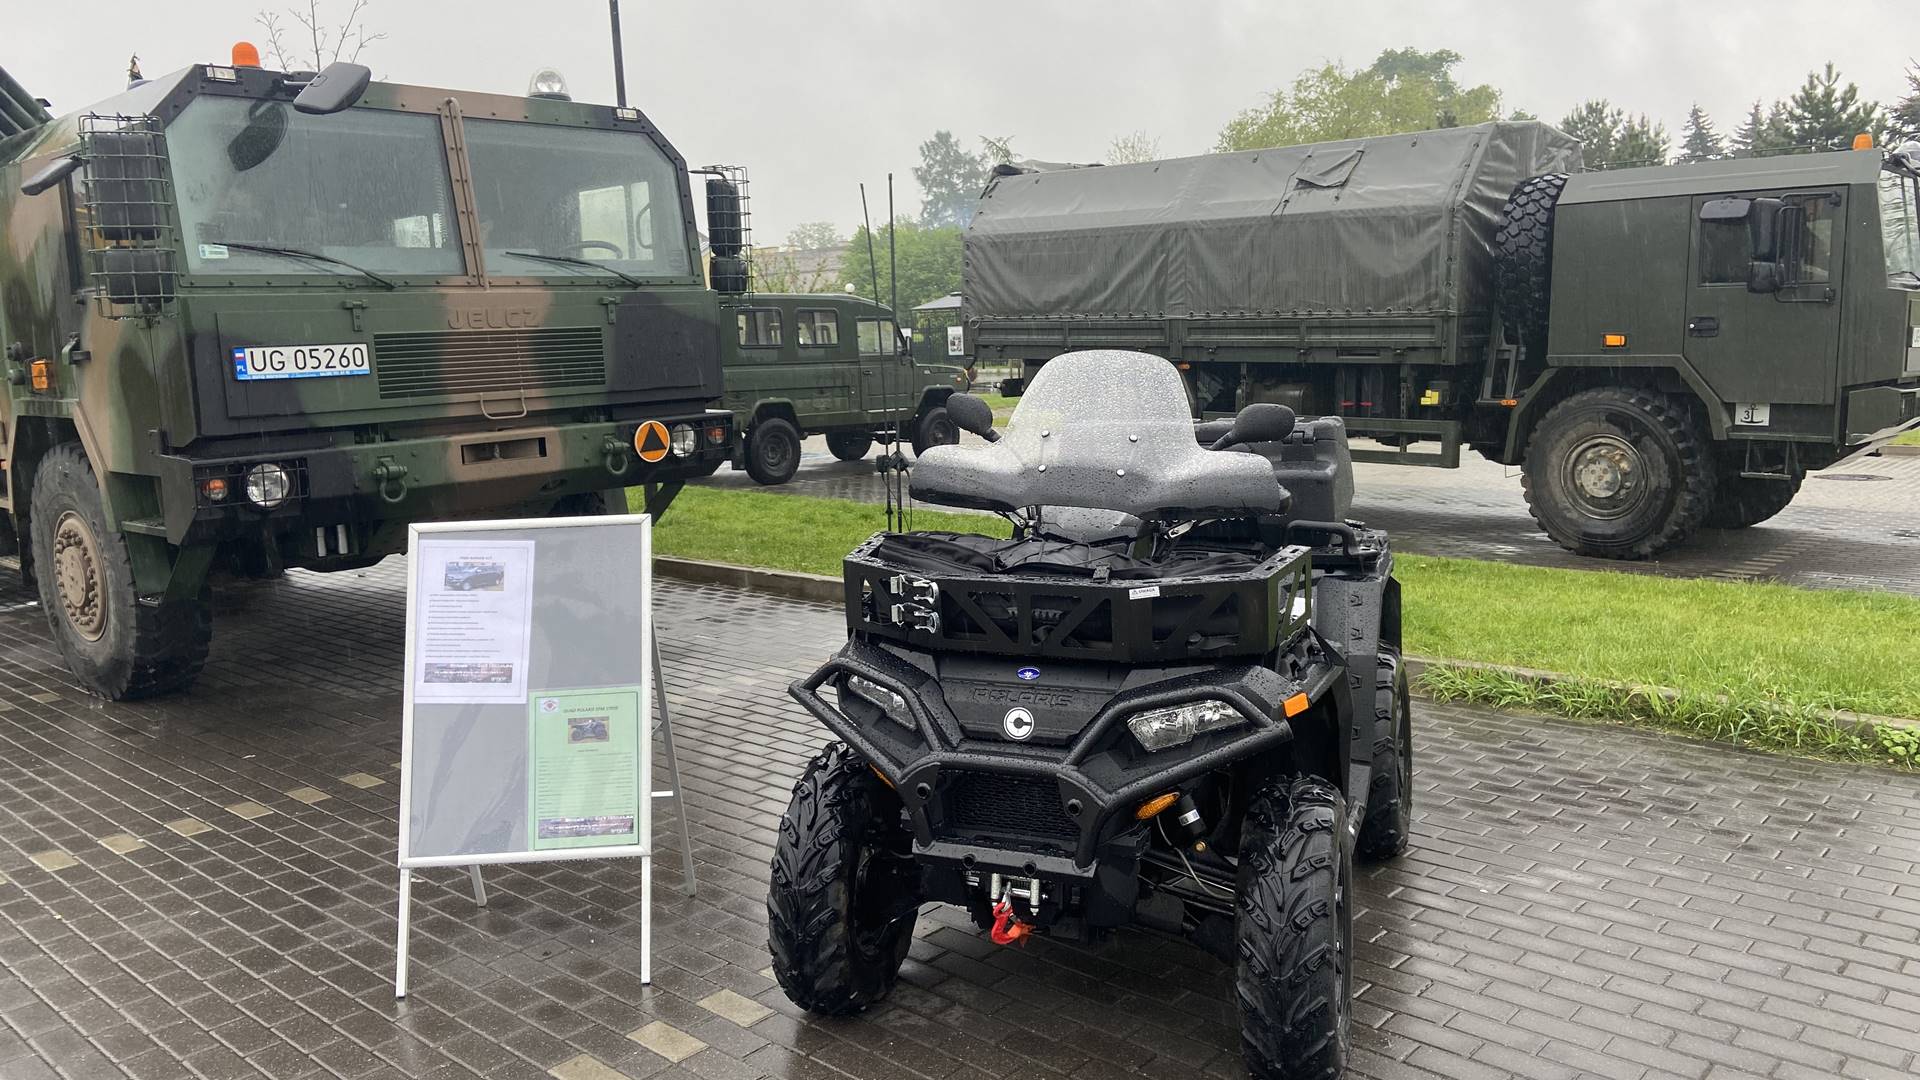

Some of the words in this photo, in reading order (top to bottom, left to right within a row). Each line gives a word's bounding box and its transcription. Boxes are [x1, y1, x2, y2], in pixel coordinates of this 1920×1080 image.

[447, 307, 541, 330] JELCZ
[250, 350, 286, 372] UG
[294, 347, 365, 370] 05260
[1744, 410, 1750, 420] 3
[972, 688, 1074, 707] POLARIS
